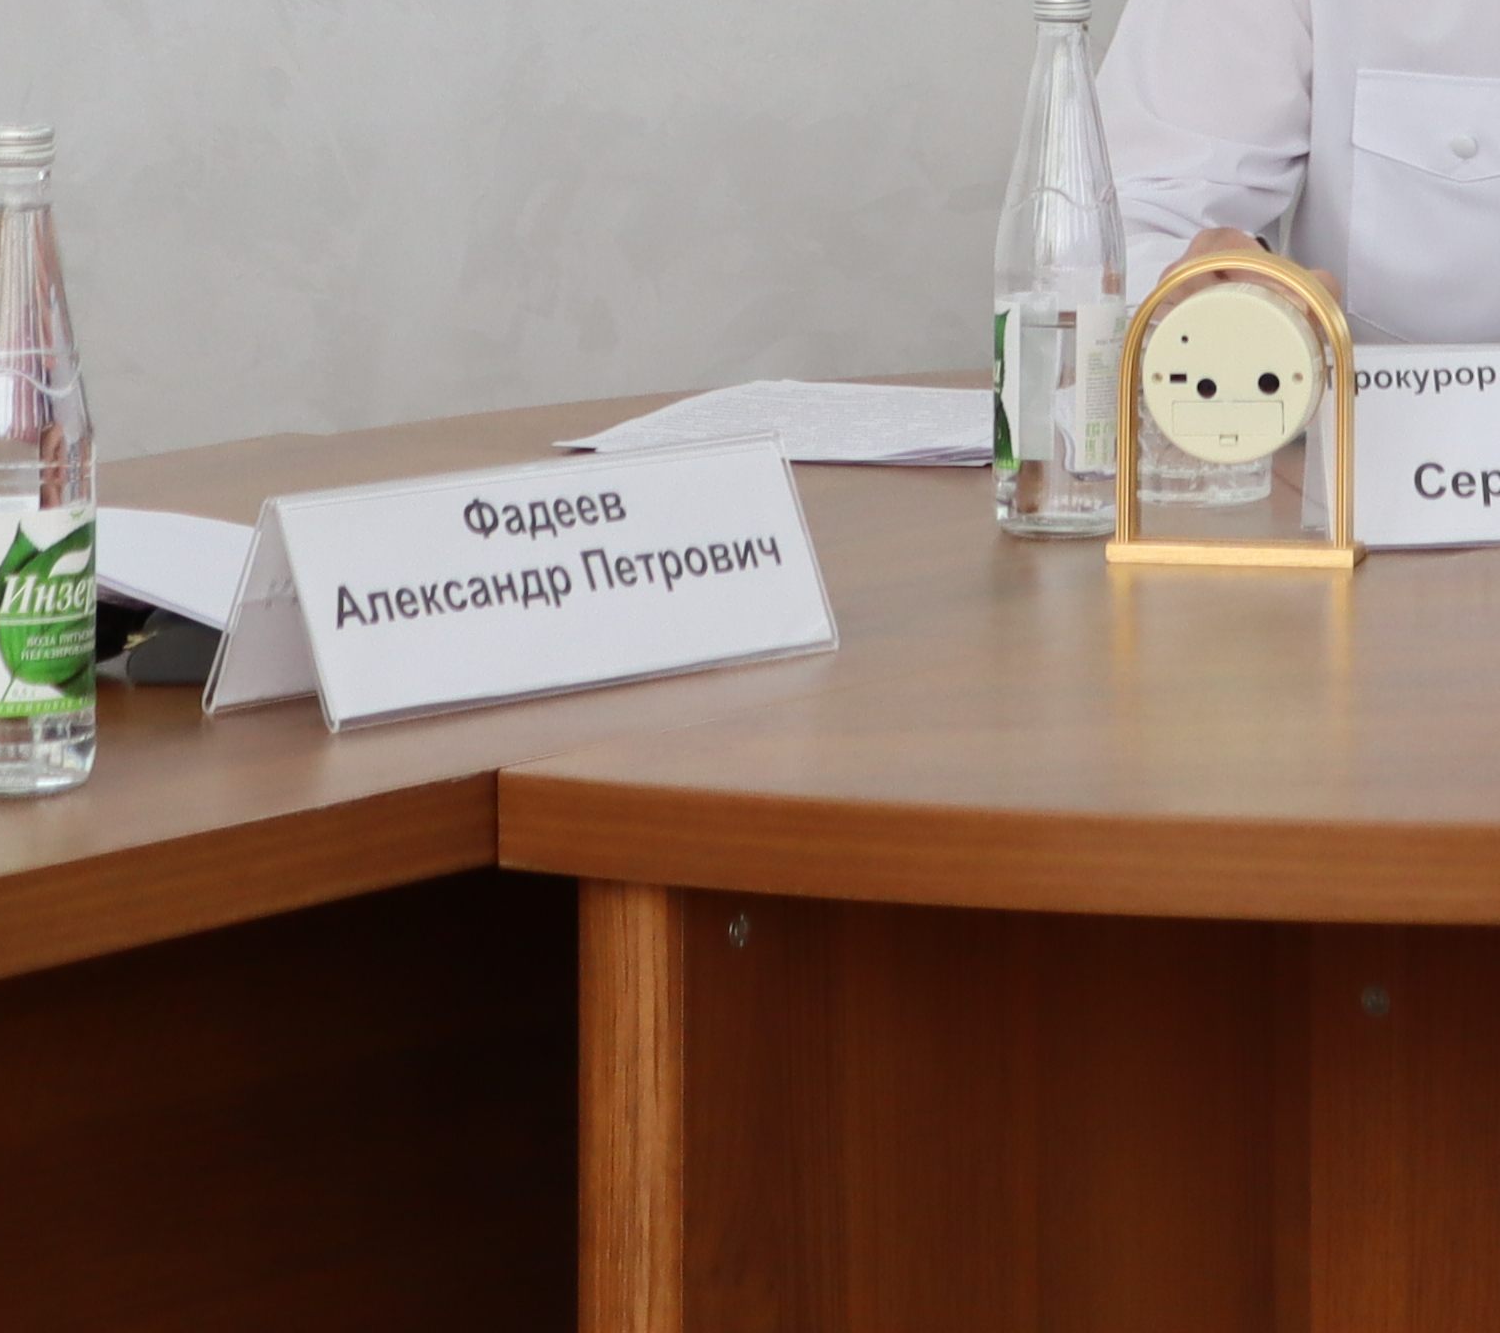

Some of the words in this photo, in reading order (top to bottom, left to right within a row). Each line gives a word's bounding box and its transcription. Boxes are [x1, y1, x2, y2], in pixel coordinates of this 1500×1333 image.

[462, 490, 627, 540] Фадеев
[336, 565, 572, 630] Александр
[579, 536, 782, 592] Петрович
